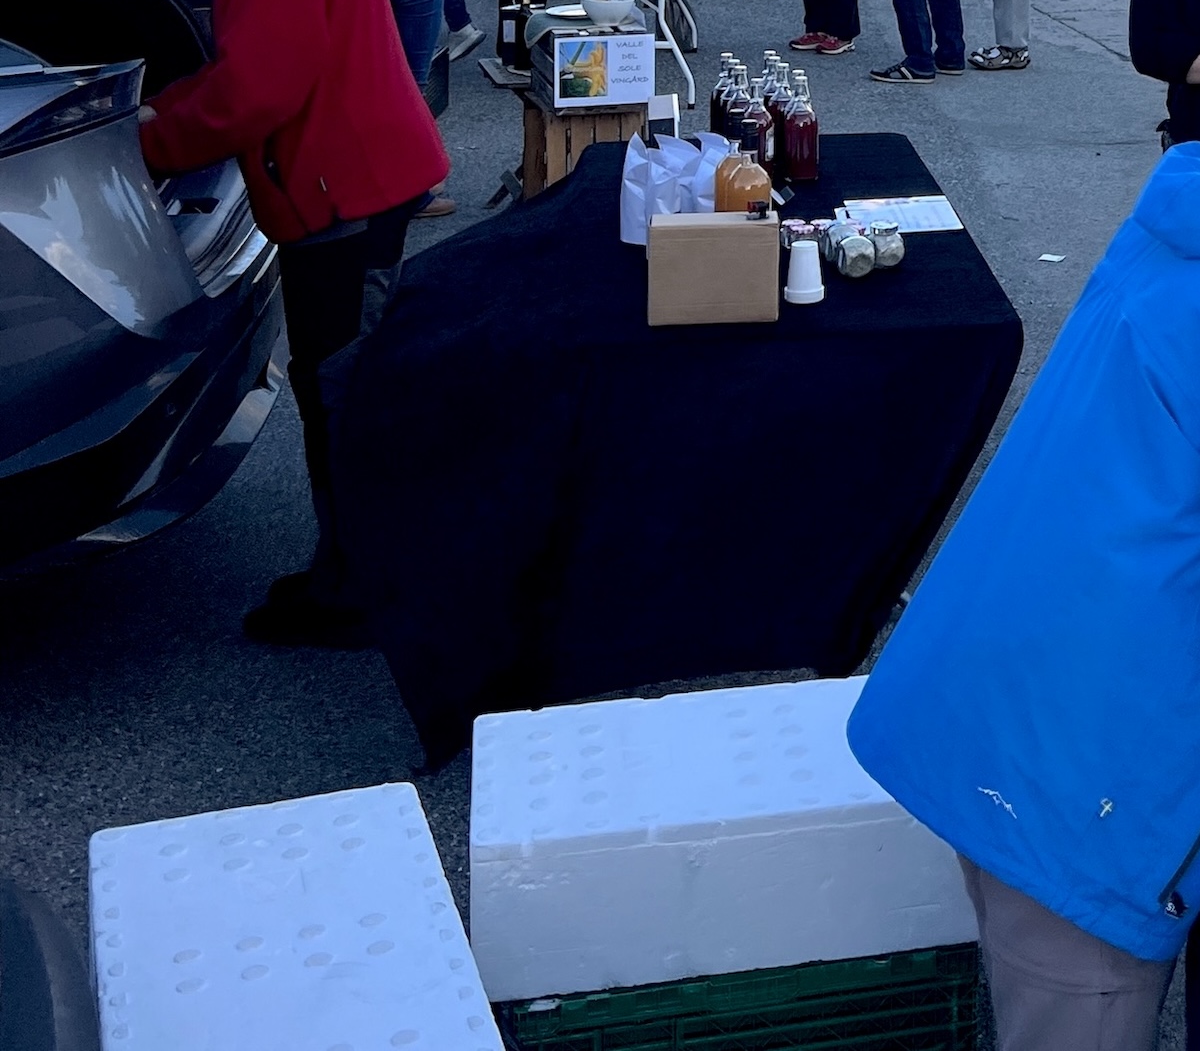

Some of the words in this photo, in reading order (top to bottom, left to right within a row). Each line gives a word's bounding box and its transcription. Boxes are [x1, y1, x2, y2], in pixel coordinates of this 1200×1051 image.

[615, 40, 644, 48] VALLE
[617, 64, 642, 72] SOLE
[610, 75, 650, 85] VINGÅRD
